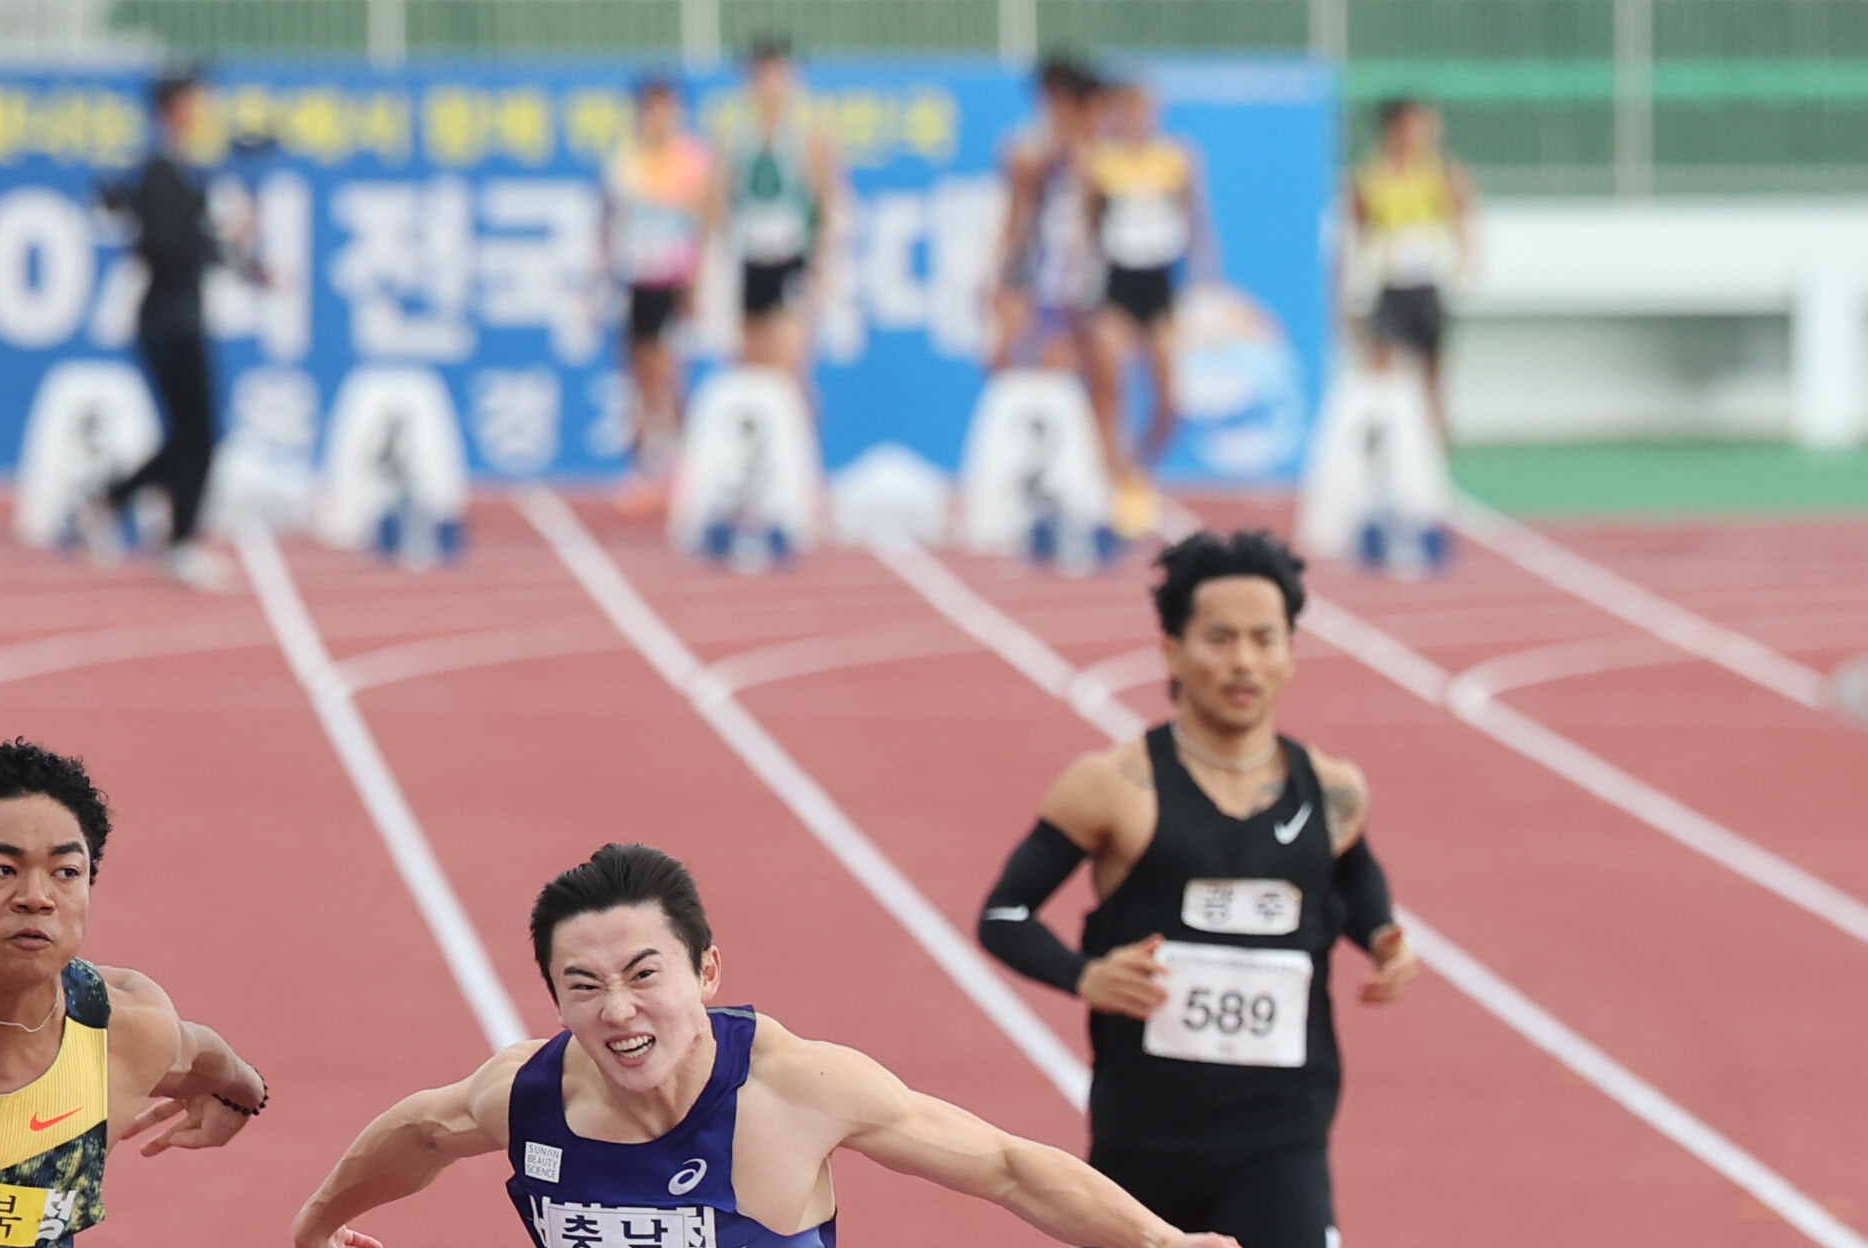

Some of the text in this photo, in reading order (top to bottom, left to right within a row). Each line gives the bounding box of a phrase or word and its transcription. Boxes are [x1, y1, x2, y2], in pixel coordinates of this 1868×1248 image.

[1183, 985, 1278, 1039] 589
[528, 1144, 560, 1159] SUNJIN
[527, 1154, 558, 1168] BEAUTY
[526, 1164, 557, 1179] SCIENCE
